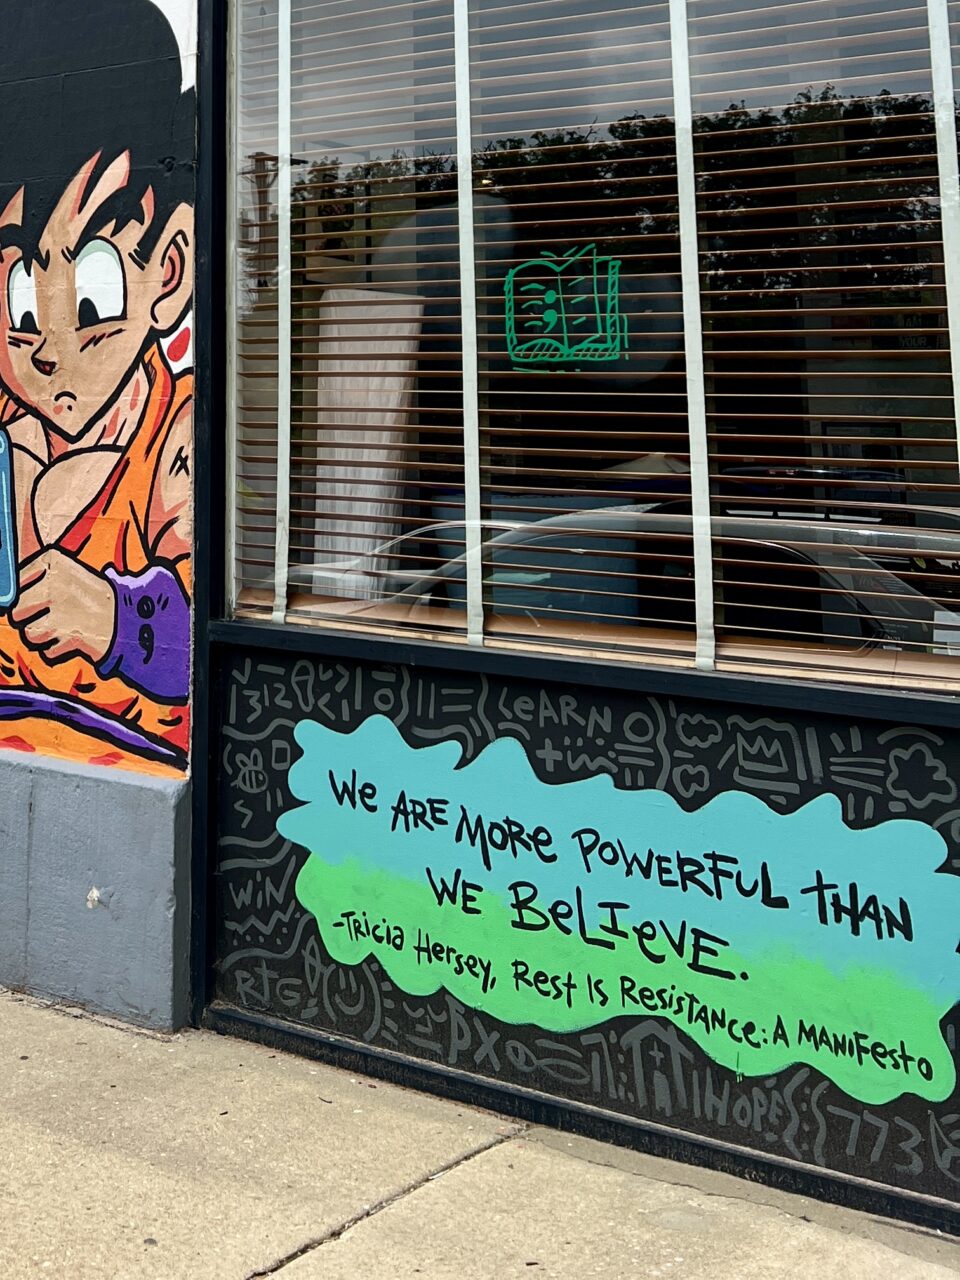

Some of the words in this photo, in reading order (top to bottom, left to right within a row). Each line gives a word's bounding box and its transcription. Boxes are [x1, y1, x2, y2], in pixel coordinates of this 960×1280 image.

[328, 769, 378, 813] We
[391, 790, 450, 833] ARE
[425, 867, 484, 915] WE
[511, 959, 578, 1009] Rest
[586, 972, 609, 1008] Is
[773, 1014, 790, 1048] A
